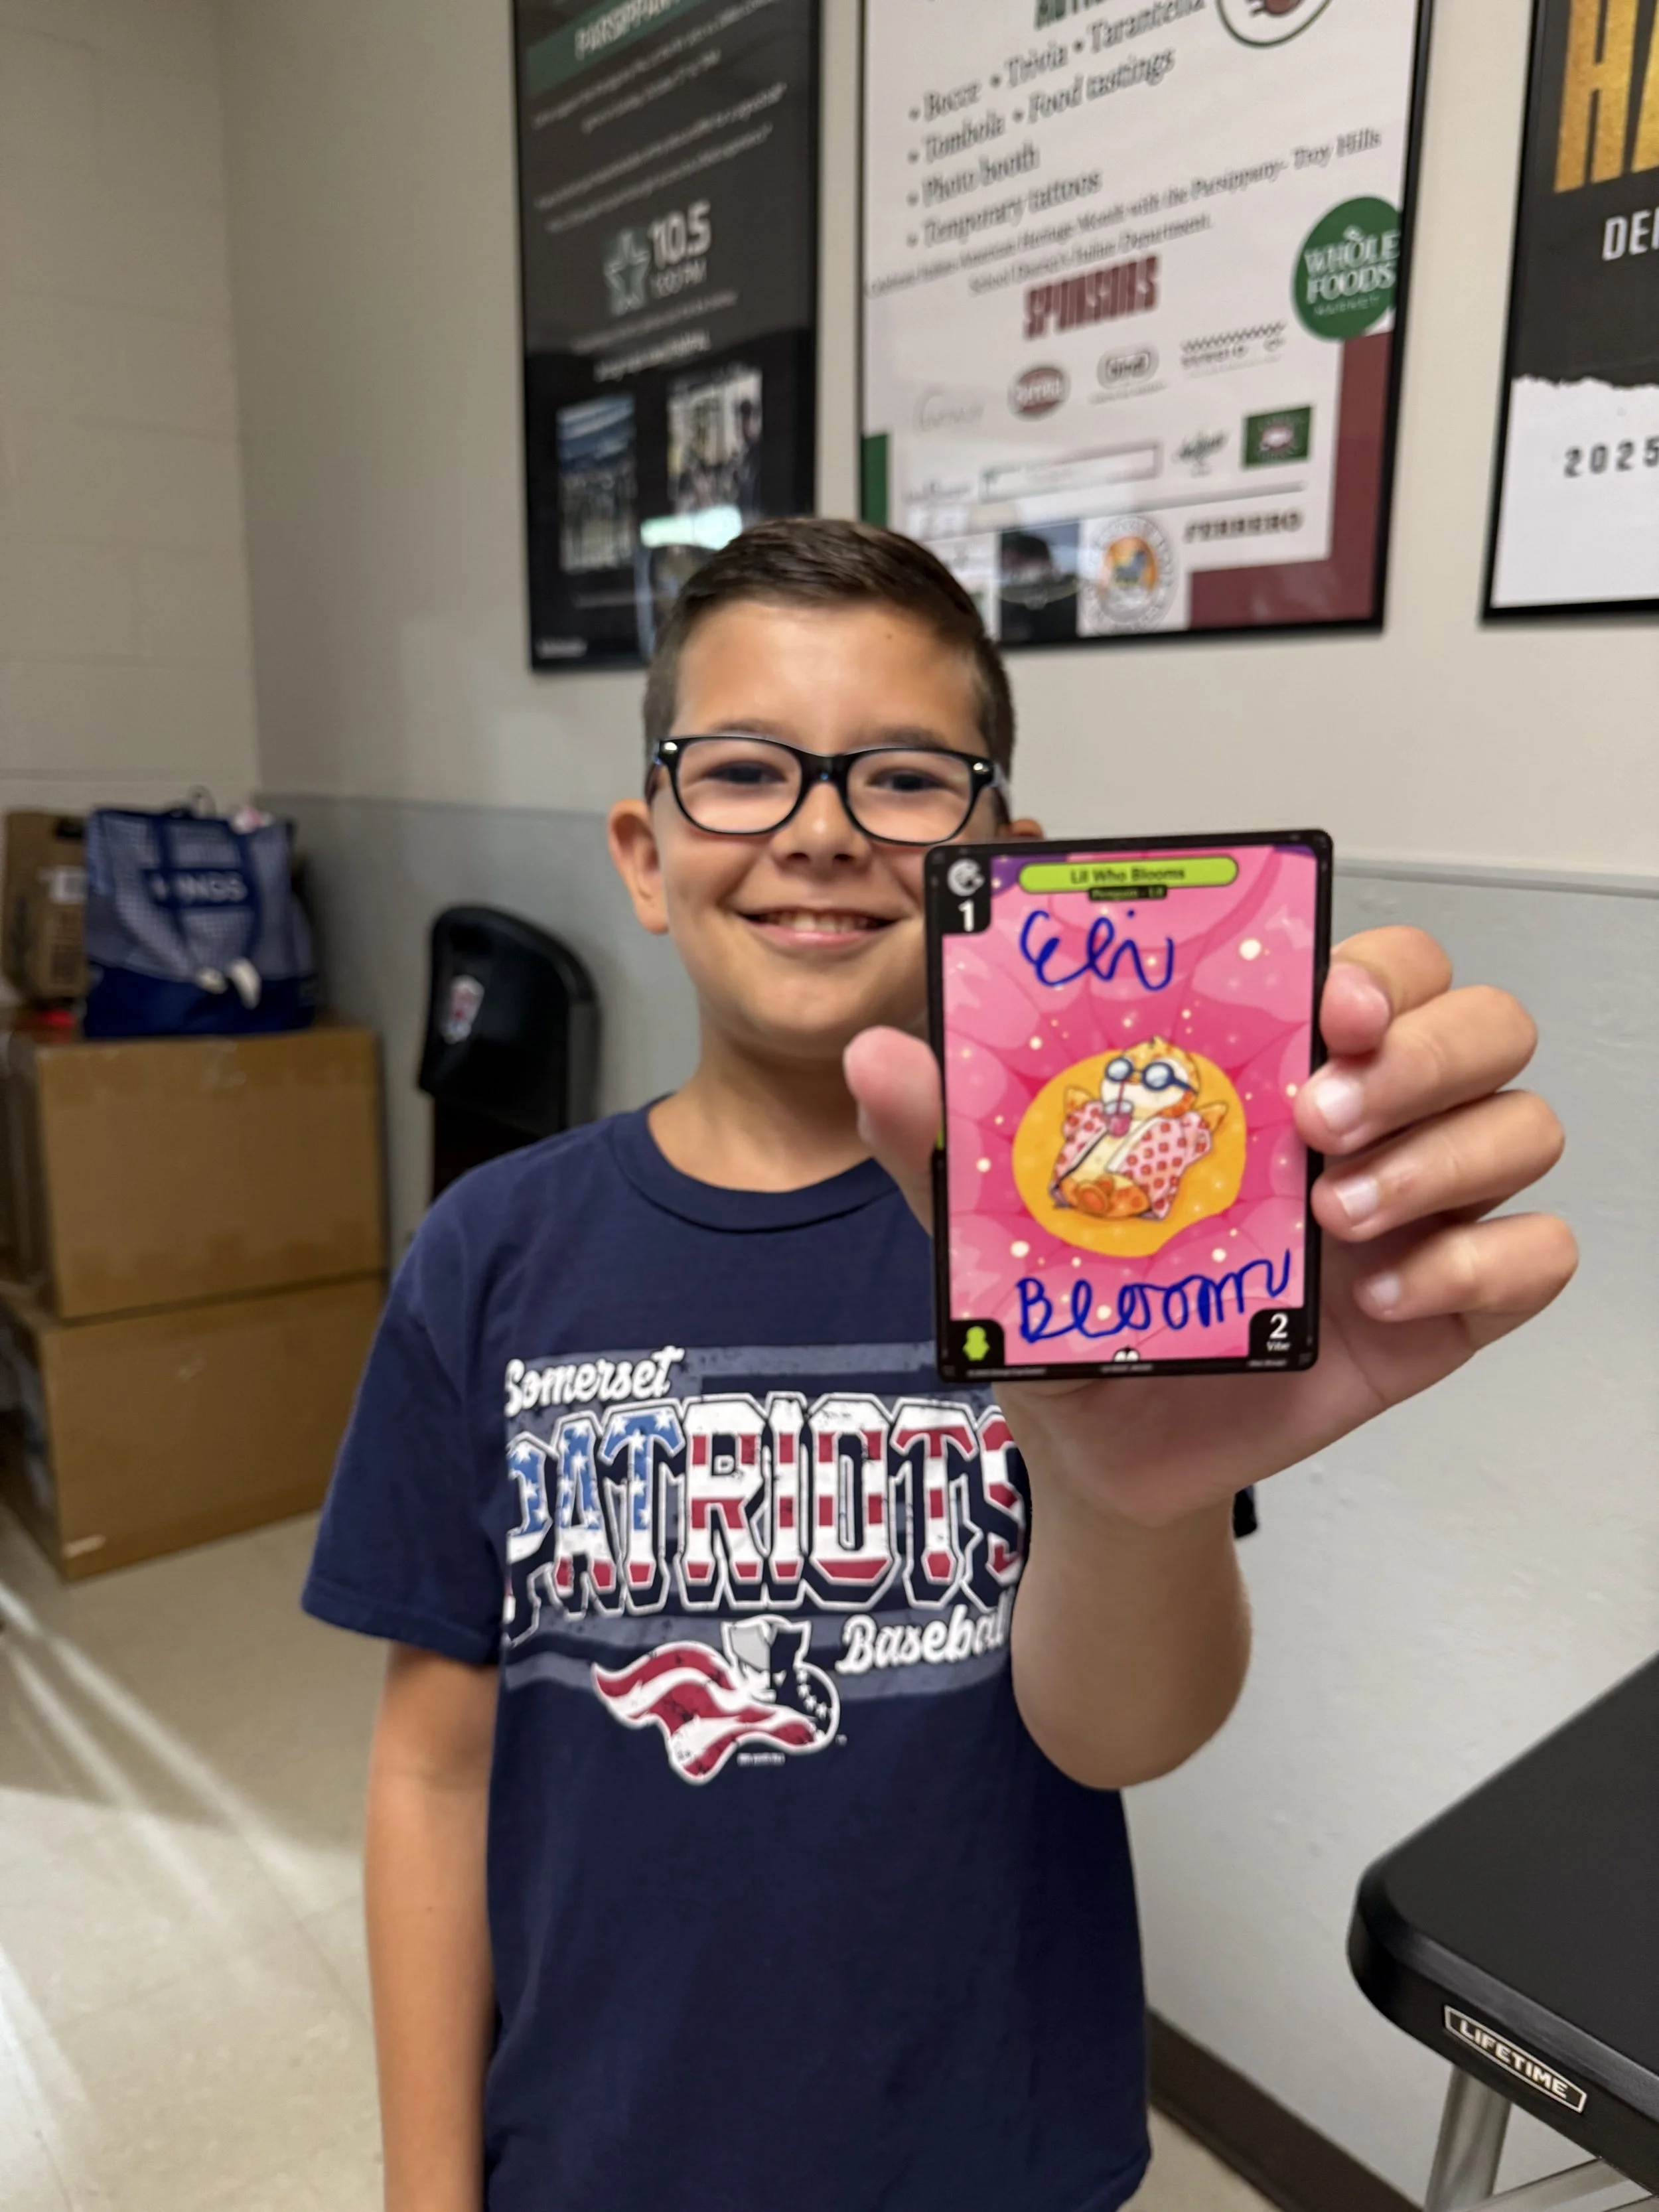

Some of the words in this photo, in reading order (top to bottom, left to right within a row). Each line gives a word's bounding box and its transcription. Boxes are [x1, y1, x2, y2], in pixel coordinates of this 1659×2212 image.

[924, 82, 981, 121] Bocce
[1005, 40, 1068, 89] Trivia
[924, 109, 1005, 165] Tombola
[1029, 75, 1083, 124] Food
[1086, 48, 1175, 102] tastings
[922, 174, 978, 208] Photo
[979, 139, 1041, 186] booth
[1293, 145, 1333, 170] Troy
[1336, 127, 1382, 158] Hills
[924, 197, 1027, 248] Temporary
[1029, 169, 1102, 214] tattoos
[1304, 228, 1400, 275] WHOLE
[1602, 207, 1659, 261] DE
[1307, 262, 1396, 304] FOODS
[1563, 435, 1659, 479] 2025
[1070, 869, 1088, 885] Lil
[1092, 868, 1127, 883] Who
[1131, 867, 1185, 881] Blooms
[958, 899, 974, 932] 1
[1269, 1312, 1288, 1339] 2
[504, 1345, 685, 1418] Somerset
[1459, 2018, 1569, 2099] LIFETIME
